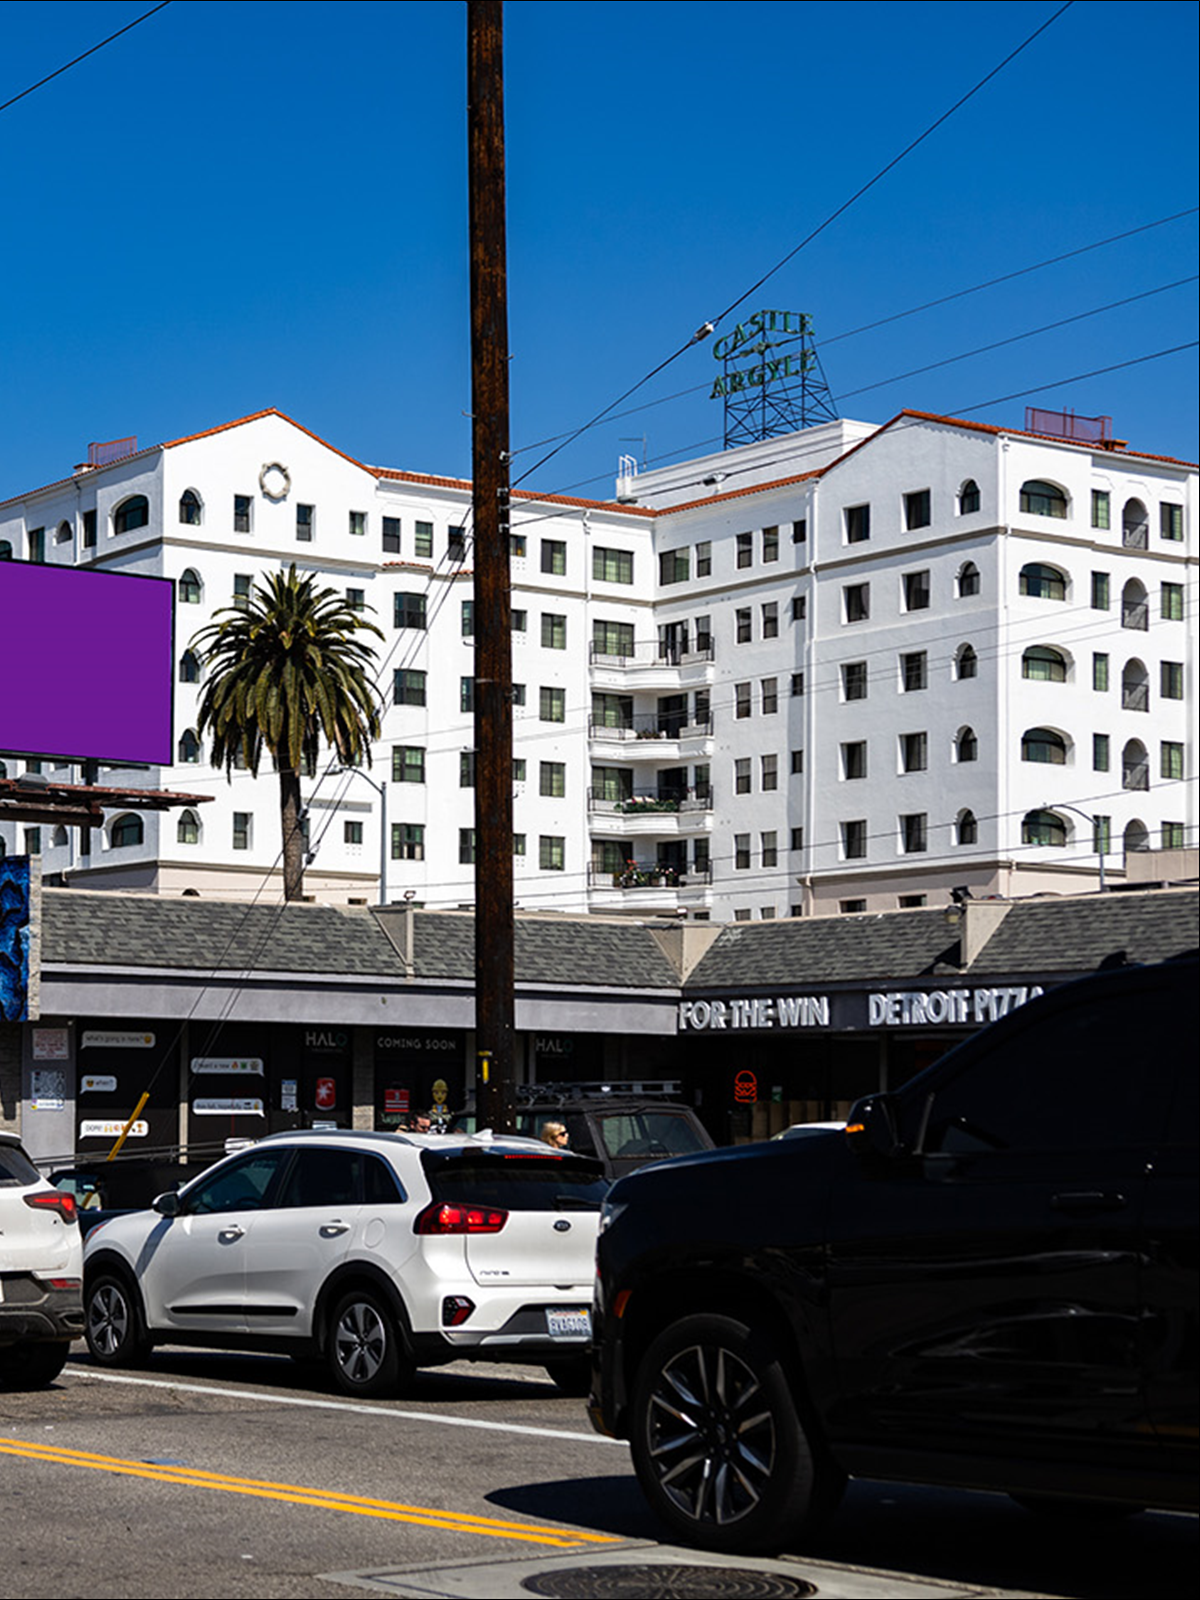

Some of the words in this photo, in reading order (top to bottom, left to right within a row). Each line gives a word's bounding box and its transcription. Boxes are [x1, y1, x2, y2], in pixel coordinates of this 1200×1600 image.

[712, 309, 815, 361] CASTLE
[709, 349, 816, 399] ARGYLE
[679, 1000, 727, 1029] FOR
[729, 998, 773, 1028] THE
[775, 997, 830, 1027] WIN
[868, 988, 970, 1026] DETROIT
[305, 1031, 347, 1047] HALO
[377, 1036, 422, 1049] COMING
[425, 1038, 456, 1050] SOON
[535, 1037, 574, 1054] HALO
